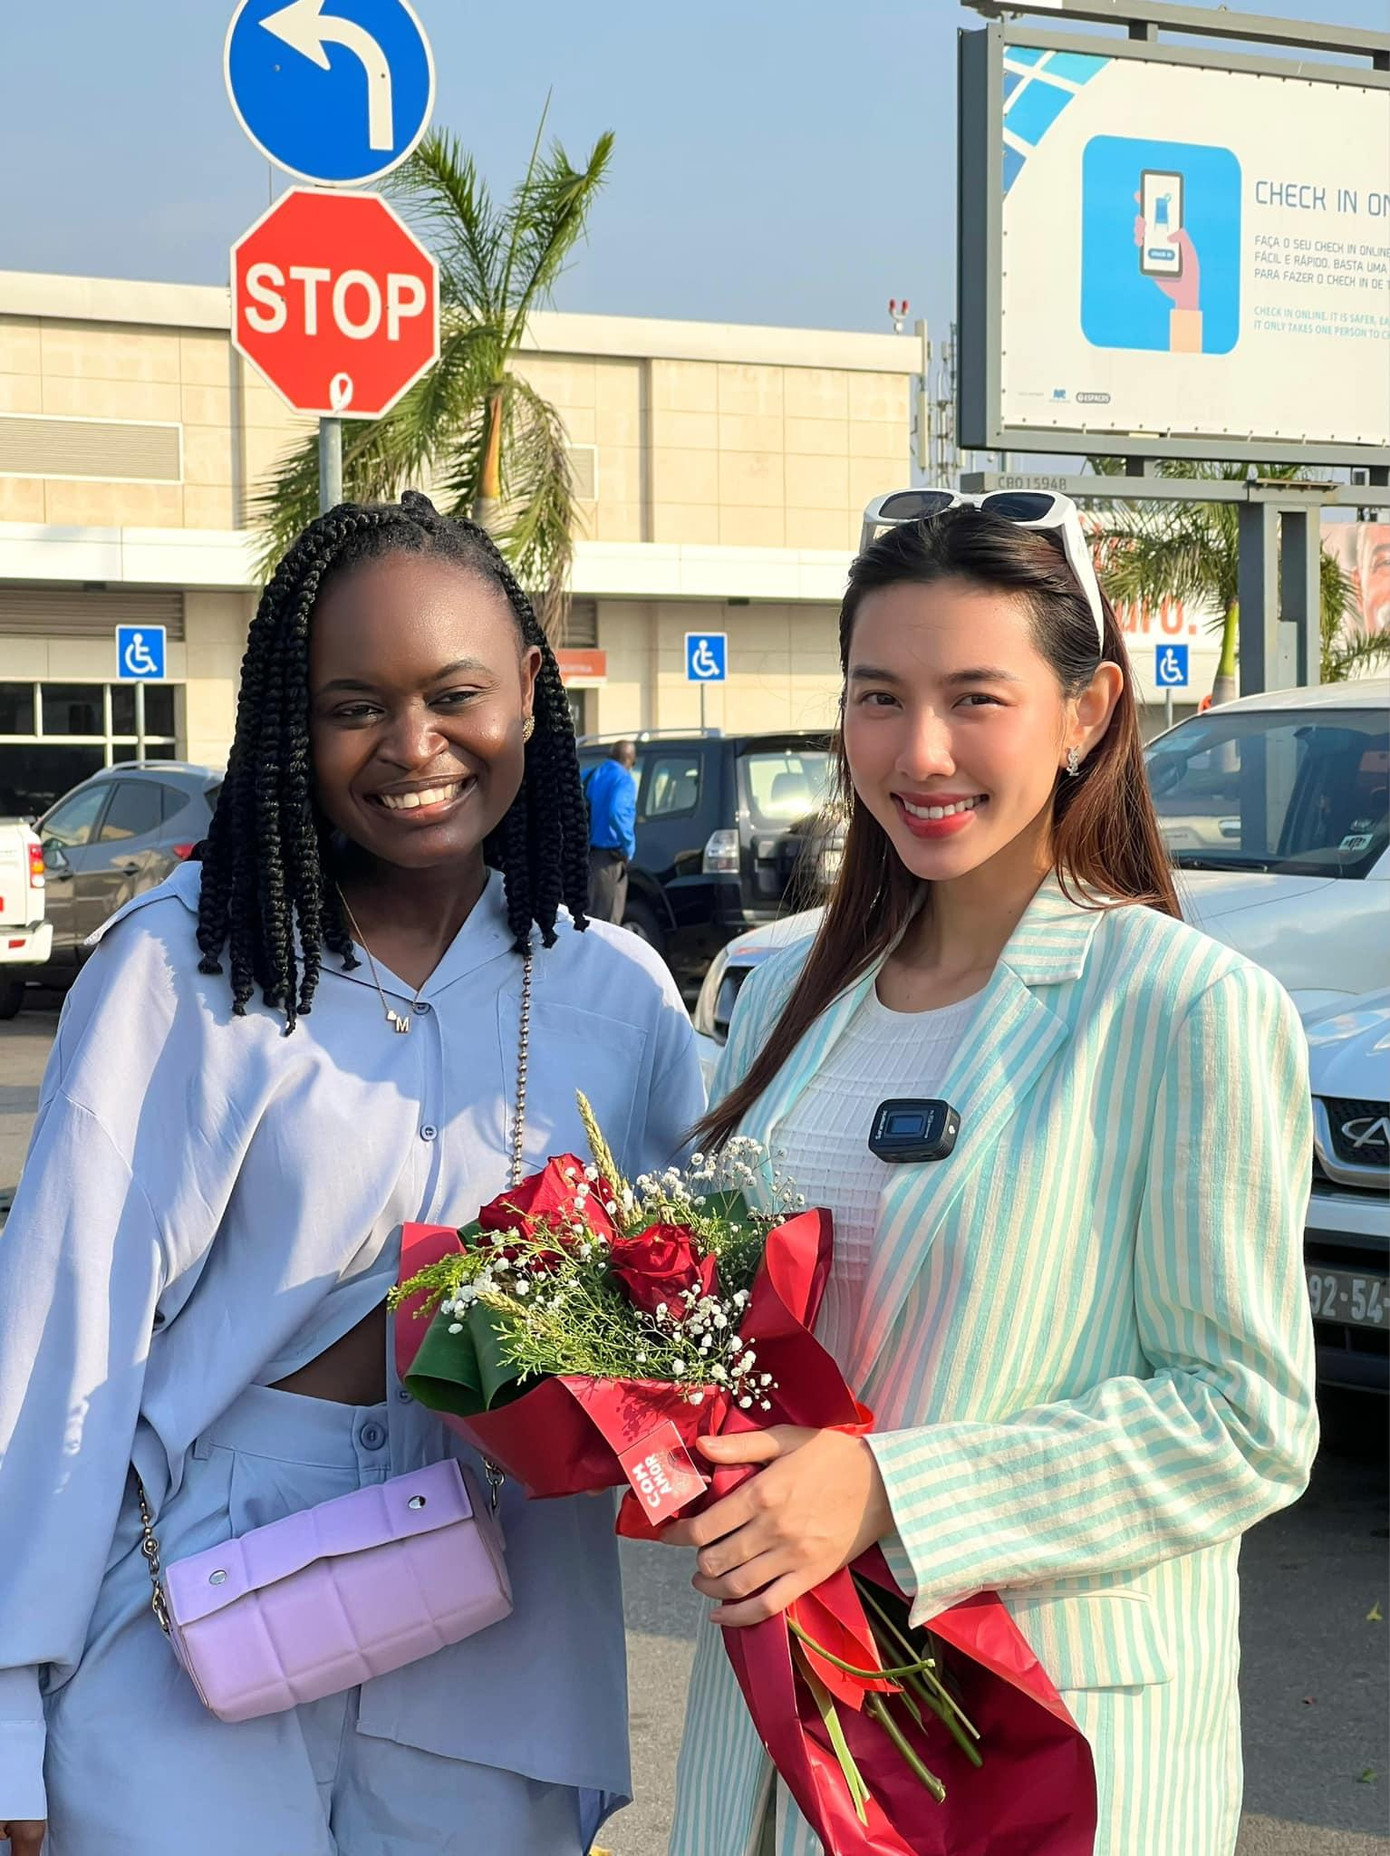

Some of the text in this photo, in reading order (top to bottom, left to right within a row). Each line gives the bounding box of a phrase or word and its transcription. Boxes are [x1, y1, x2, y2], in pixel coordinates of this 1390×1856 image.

[1255, 181, 1326, 211] CHECK
[1337, 188, 1357, 214] IN
[1255, 235, 1280, 249] FAÇA
[1283, 237, 1290, 249] O
[1293, 238, 1312, 251] SEU
[1315, 241, 1345, 254] CHECK
[1347, 243, 1357, 255] IN
[1285, 254, 1291, 265] E
[1333, 259, 1363, 271] BASTA
[1367, 262, 1388, 273] UMA
[1254, 268, 1280, 280] PARA
[1283, 271, 1314, 283] FAZER
[1317, 273, 1324, 285] O
[1327, 275, 1356, 287] CHECK
[1359, 277, 1368, 288] IN
[1371, 278, 1383, 290] DE
[244, 262, 427, 341] STOP
[1254, 306, 1281, 317] CHECK
[1284, 308, 1293, 318] IN
[1330, 311, 1338, 321] IT
[1340, 312, 1348, 322] IS
[1254, 320, 1262, 330] IT
[1263, 320, 1285, 332] ONLY
[1288, 322, 1313, 334] TAKES
[1315, 324, 1332, 335] ONE
[1334, 326, 1367, 338] PERSON
[1369, 329, 1380, 339] TO
[396, 1015, 410, 1033] M
[645, 1453, 673, 1494] AMOR
[632, 1463, 661, 1508] COM
